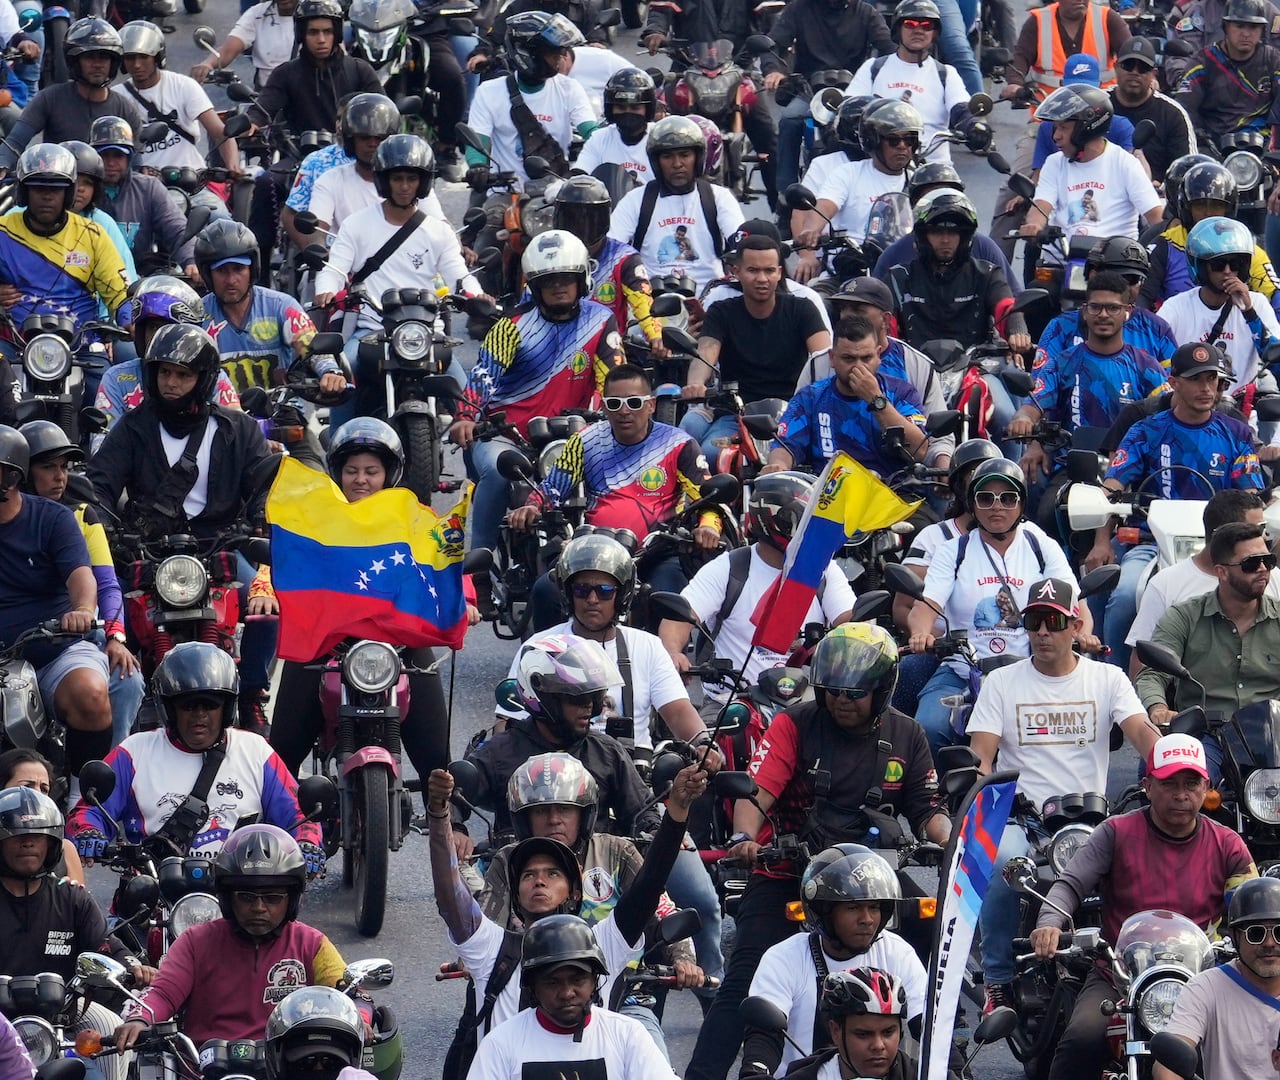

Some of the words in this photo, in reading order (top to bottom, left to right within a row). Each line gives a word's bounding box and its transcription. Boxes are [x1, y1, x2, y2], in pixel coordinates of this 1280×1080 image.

[143, 133, 182, 154] adidas
[1067, 182, 1105, 192] LIBERTAD
[658, 217, 695, 228] LIBERTAD
[1024, 711, 1088, 727] TOMMY
[1049, 725, 1087, 736] JEANS
[749, 739, 772, 776] AXI
[43, 944, 72, 956] YANGO
